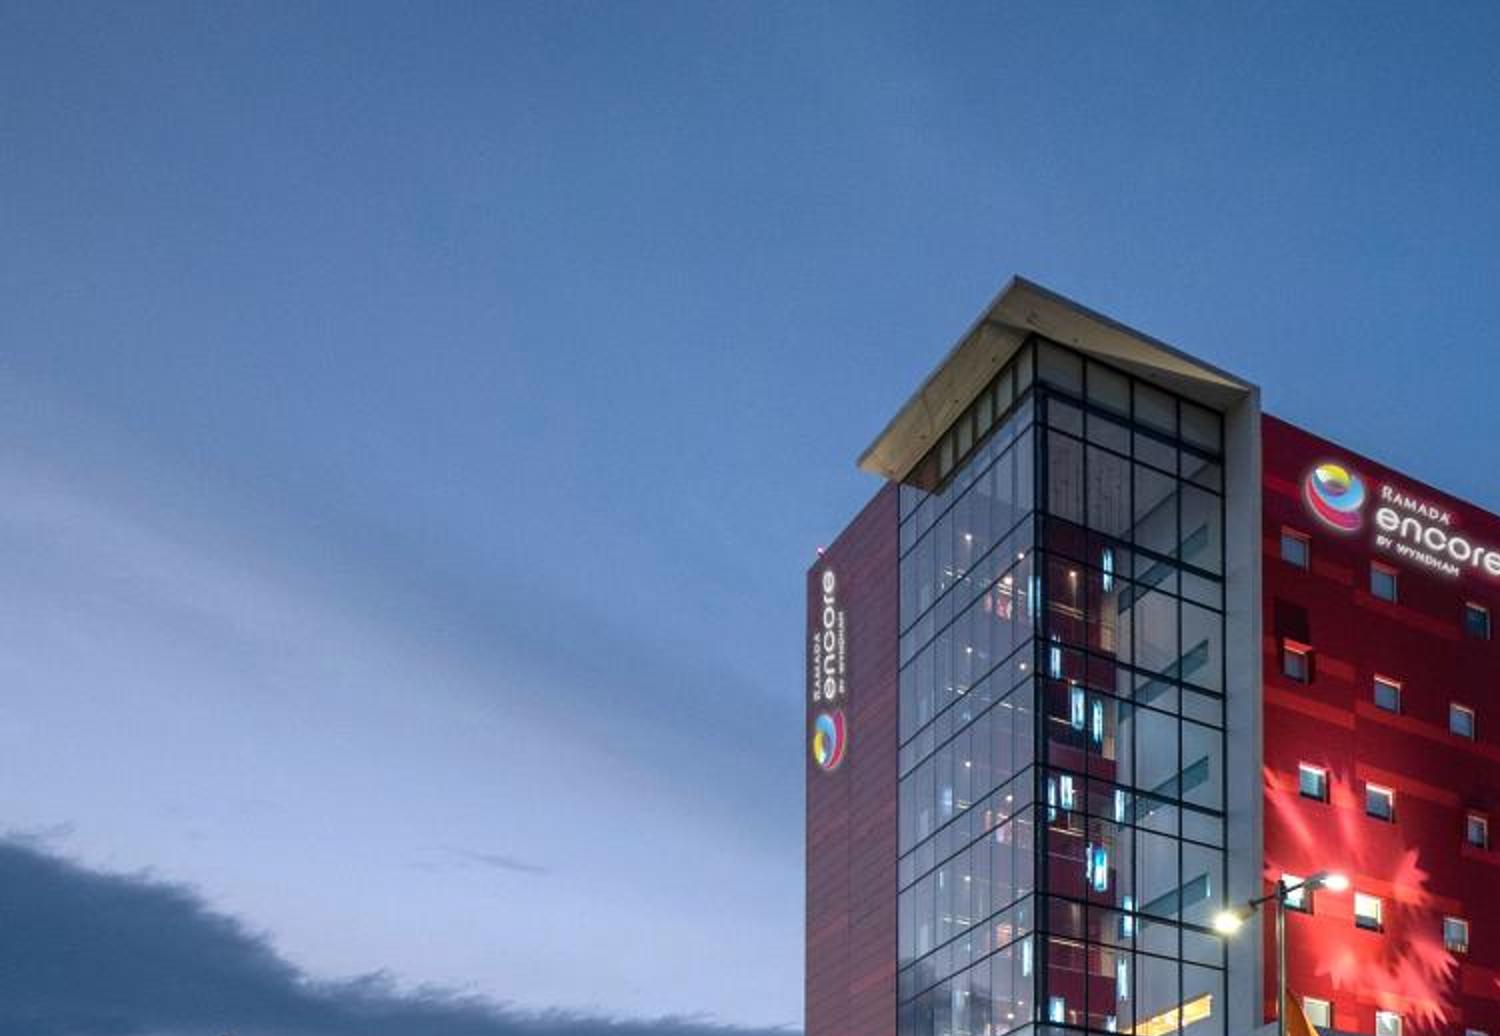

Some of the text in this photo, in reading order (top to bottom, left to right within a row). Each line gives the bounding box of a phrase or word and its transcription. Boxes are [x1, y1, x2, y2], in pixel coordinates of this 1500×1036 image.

[1381, 486, 1450, 523] RAMADA
[1376, 535, 1460, 576] BY WYNDHAM
[823, 571, 835, 700] encore
[813, 633, 821, 701] RAMADA
